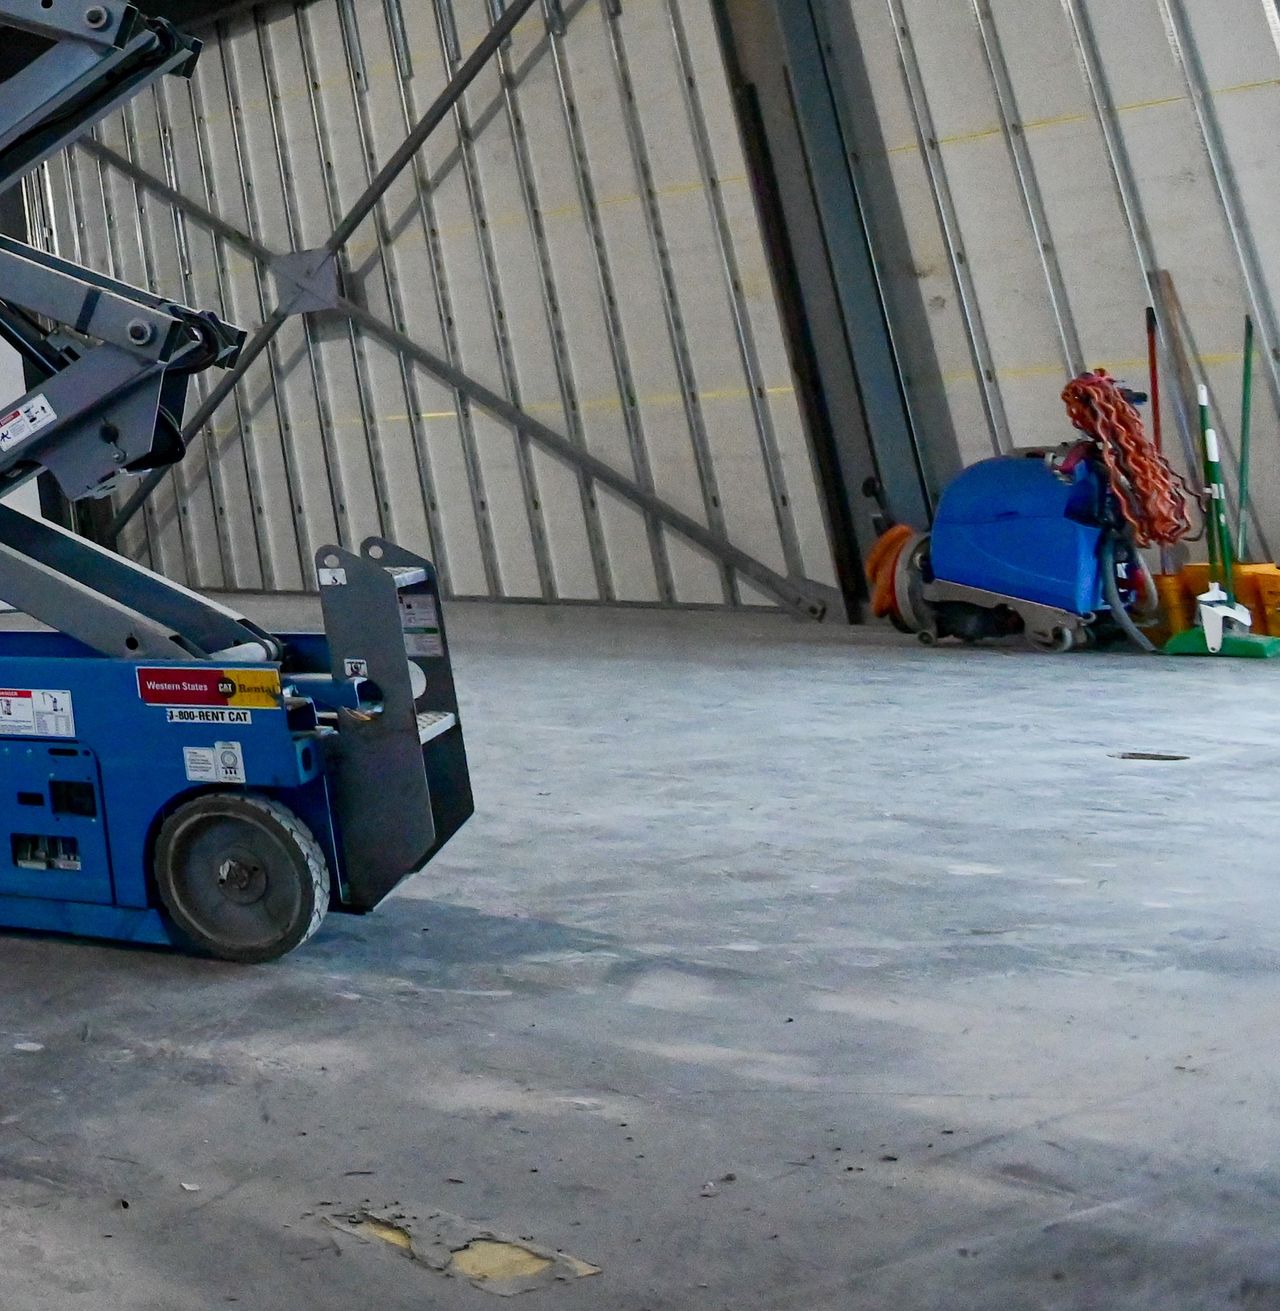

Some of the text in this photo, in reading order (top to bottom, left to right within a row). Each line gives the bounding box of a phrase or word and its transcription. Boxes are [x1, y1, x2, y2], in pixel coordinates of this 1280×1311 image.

[146, 681, 277, 695] Western States CAT Rental
[228, 711, 248, 722] CAT
